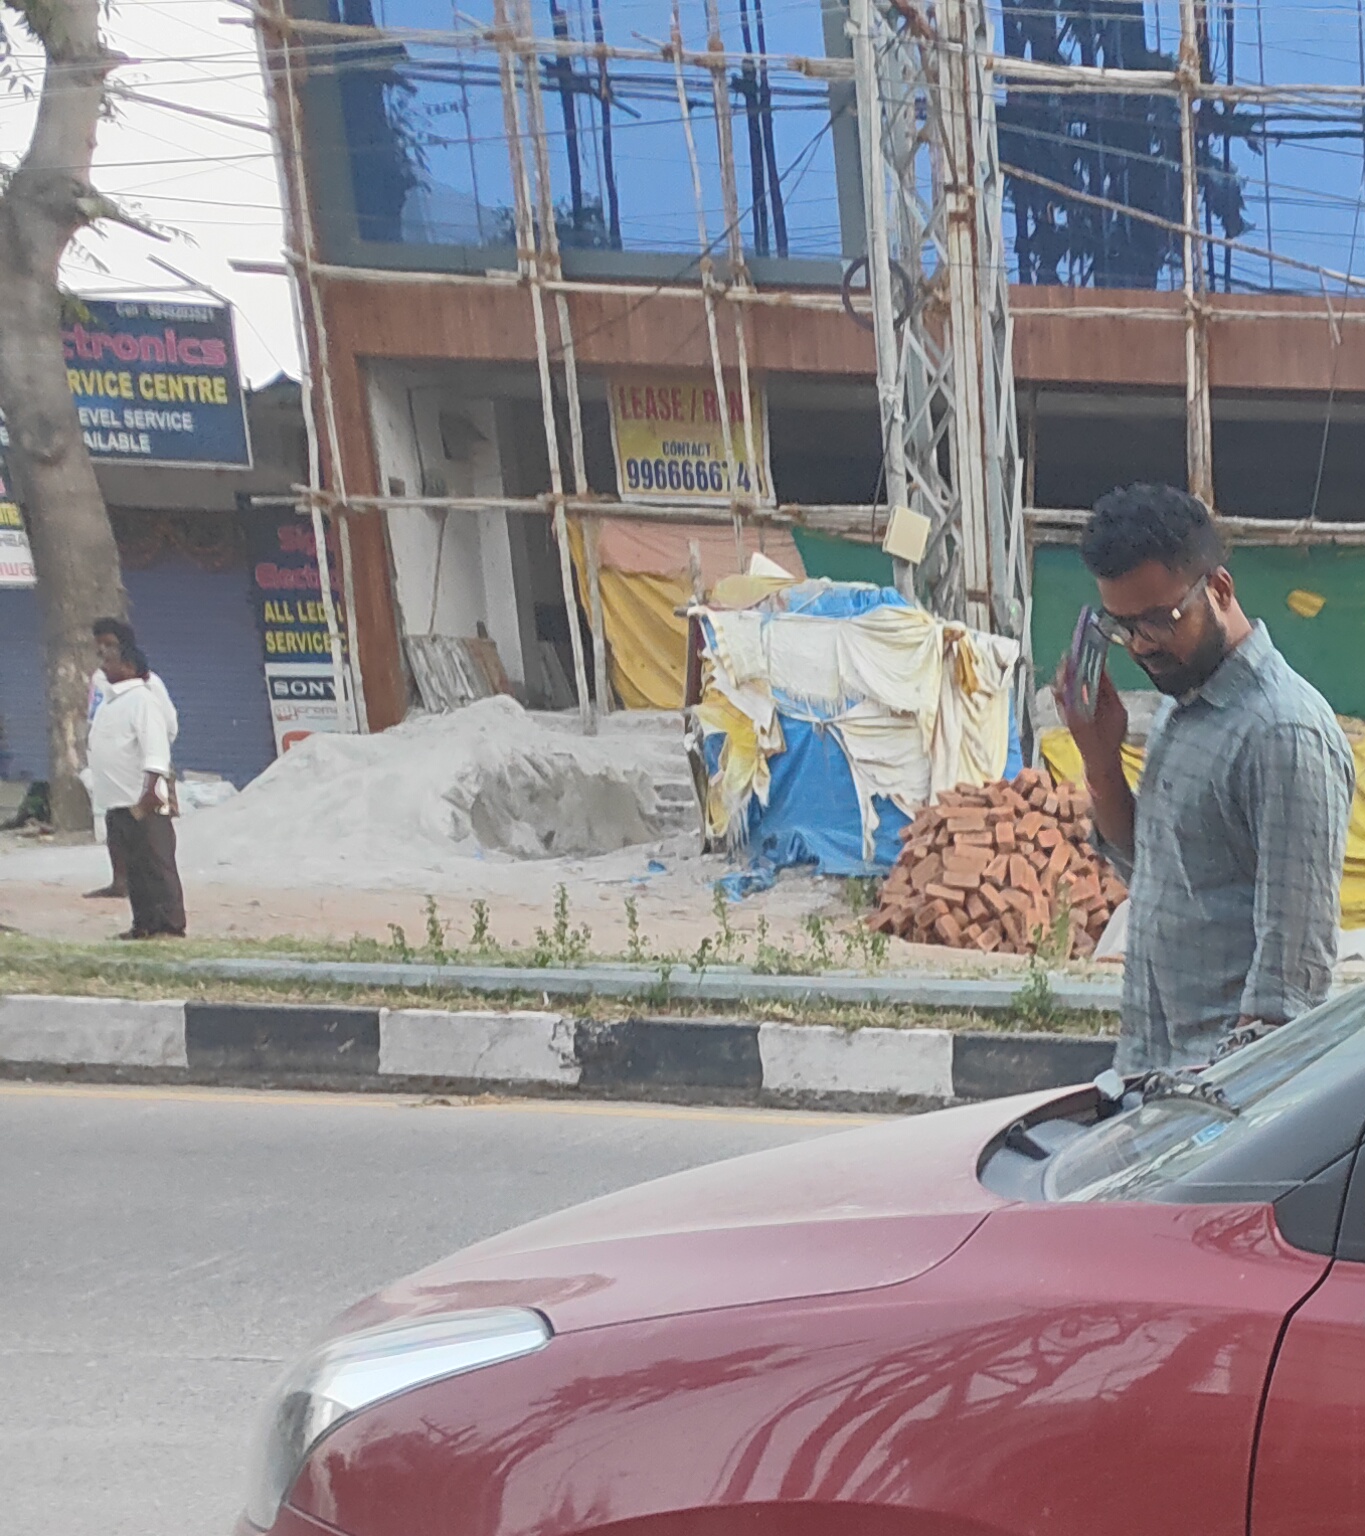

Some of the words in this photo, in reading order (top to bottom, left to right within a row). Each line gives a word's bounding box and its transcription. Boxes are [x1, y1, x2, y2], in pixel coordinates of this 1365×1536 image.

[138, 372, 227, 405] CENTRE
[619, 386, 684, 422] LEASE
[123, 408, 193, 433] SERVICE
[264, 600, 295, 623] ALL
